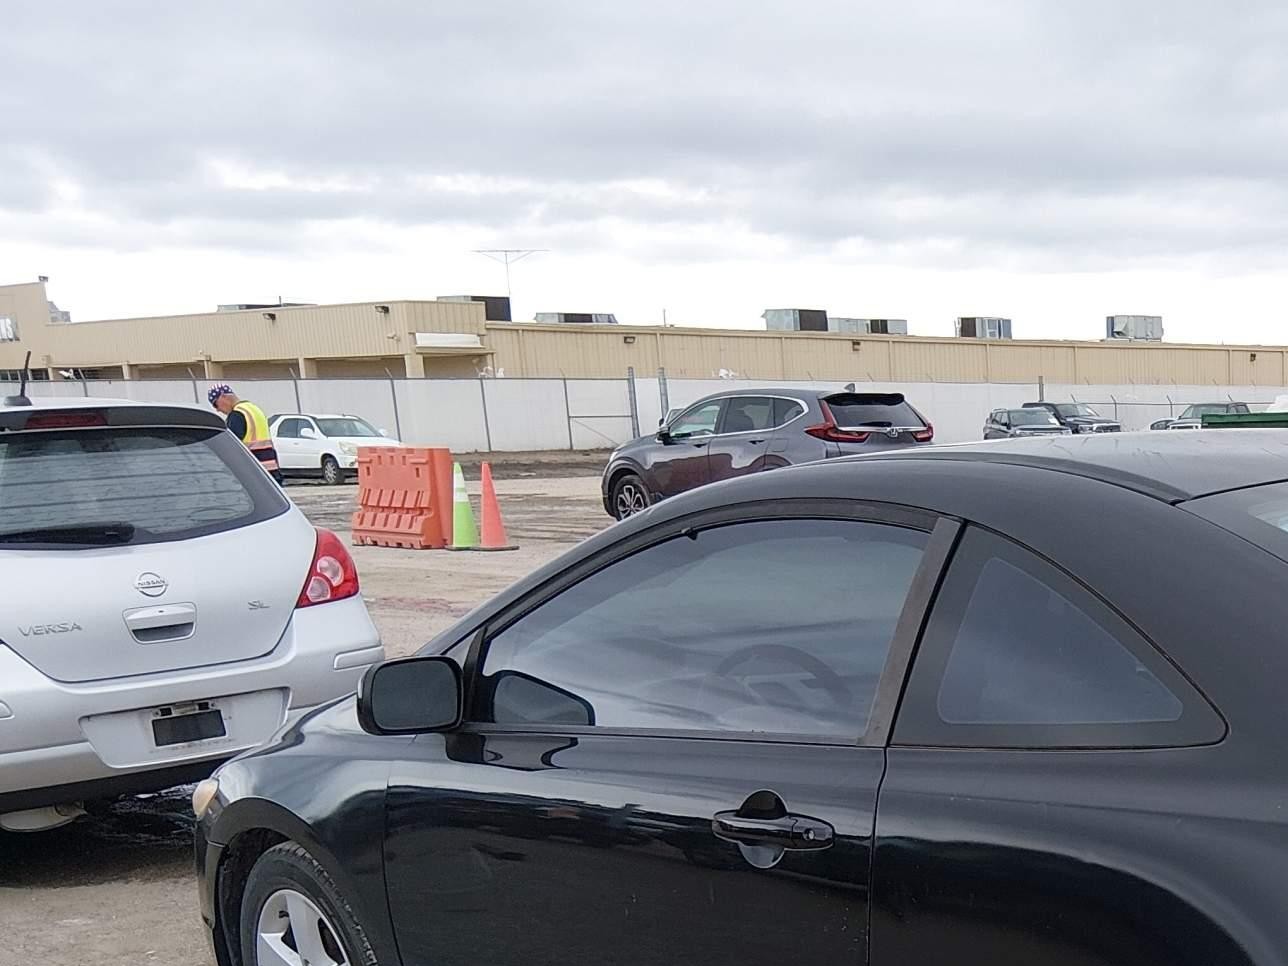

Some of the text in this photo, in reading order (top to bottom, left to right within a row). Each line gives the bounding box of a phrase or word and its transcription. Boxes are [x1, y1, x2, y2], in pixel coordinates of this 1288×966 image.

[136, 579, 166, 587] NISSAN
[247, 599, 271, 611] SL
[17, 621, 82, 637] VERSA
